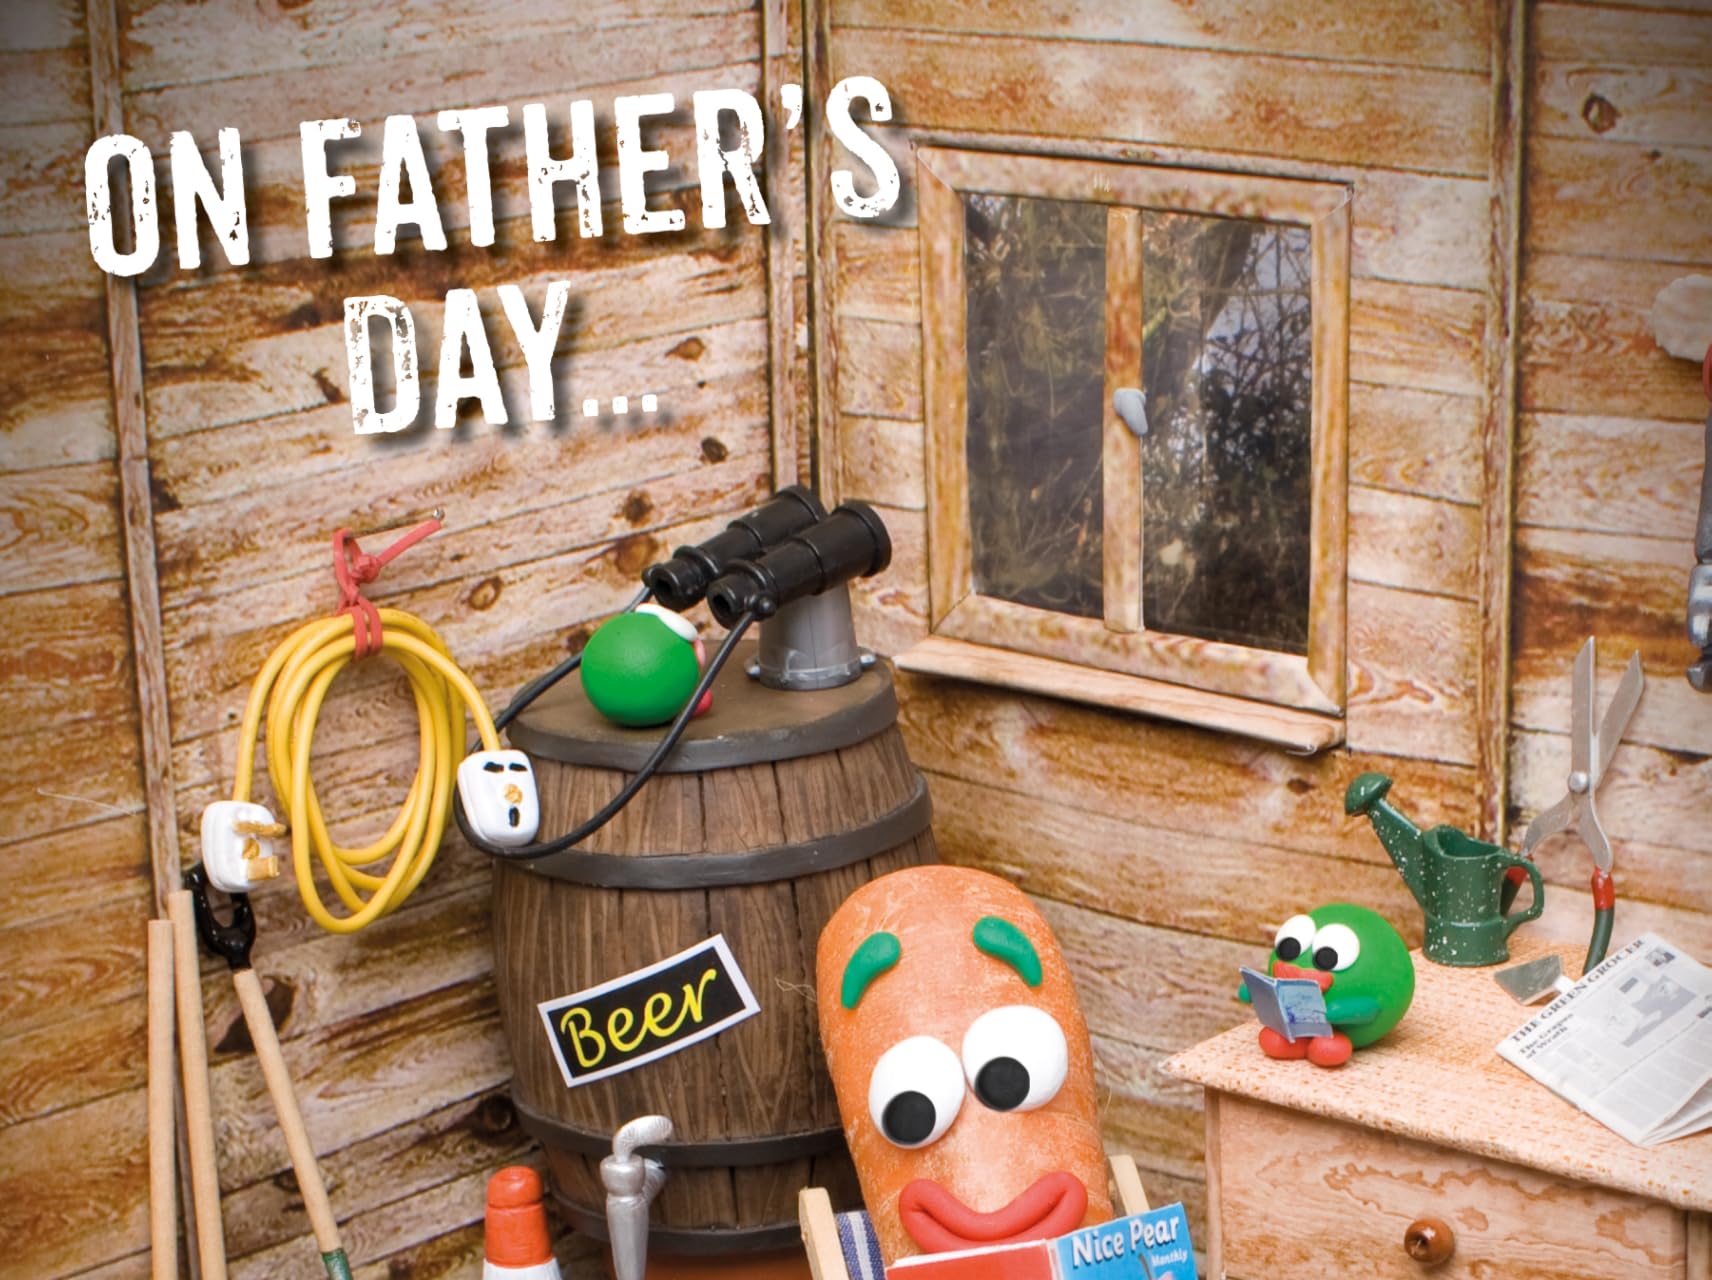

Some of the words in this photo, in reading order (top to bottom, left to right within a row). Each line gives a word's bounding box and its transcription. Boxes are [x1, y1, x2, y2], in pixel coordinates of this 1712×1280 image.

[560, 968, 717, 1068] Beer
[1512, 1018, 1541, 1043] THE
[1540, 981, 1588, 1020] GREEN
[1586, 938, 1644, 984] GROCER
[1071, 1229, 1125, 1269] Nice
[1128, 1216, 1180, 1254] Pear
[1150, 1248, 1188, 1267] Monthly
